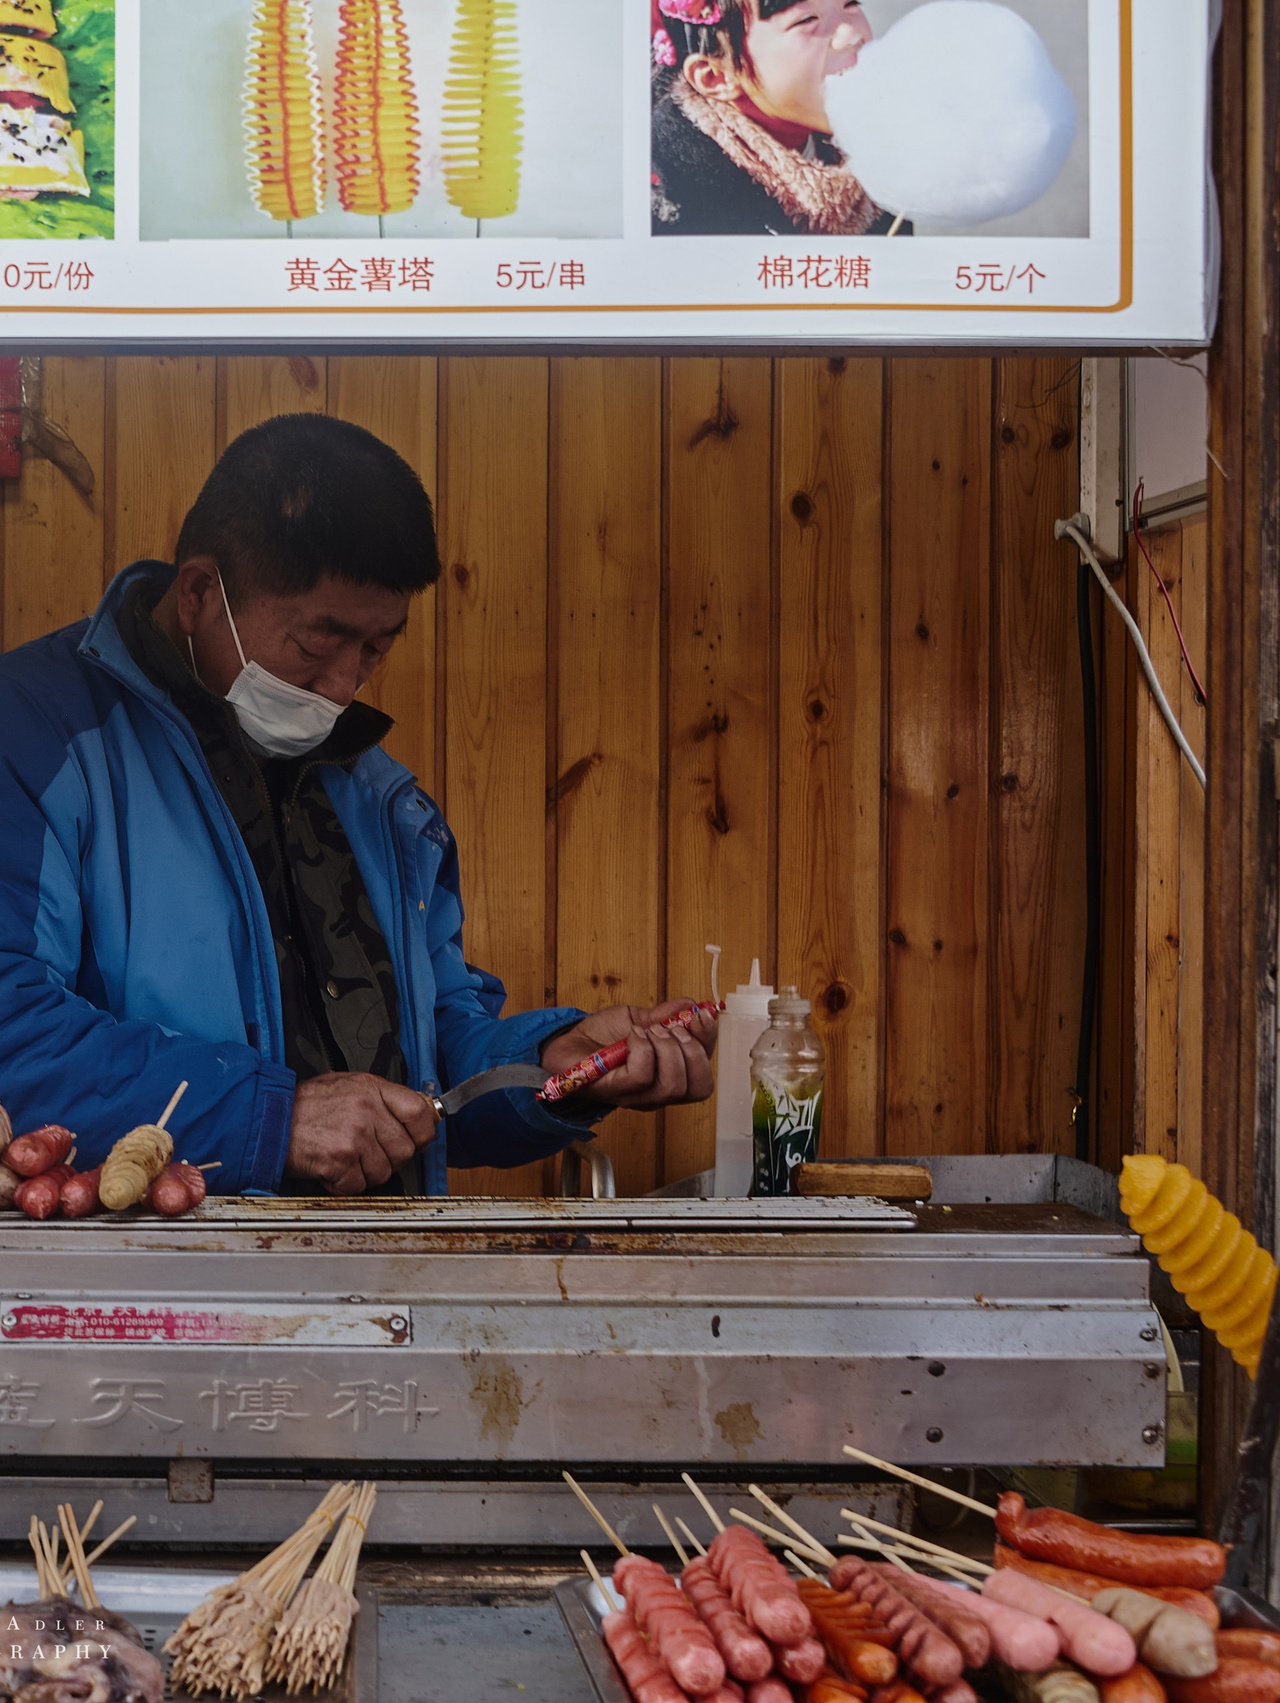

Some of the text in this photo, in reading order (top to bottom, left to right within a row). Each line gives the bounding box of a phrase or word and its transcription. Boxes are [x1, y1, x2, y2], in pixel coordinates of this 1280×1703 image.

[284, 257, 586, 293] 黄金薯塔 5元/串
[757, 255, 1046, 294] 棉花糖 5元/个
